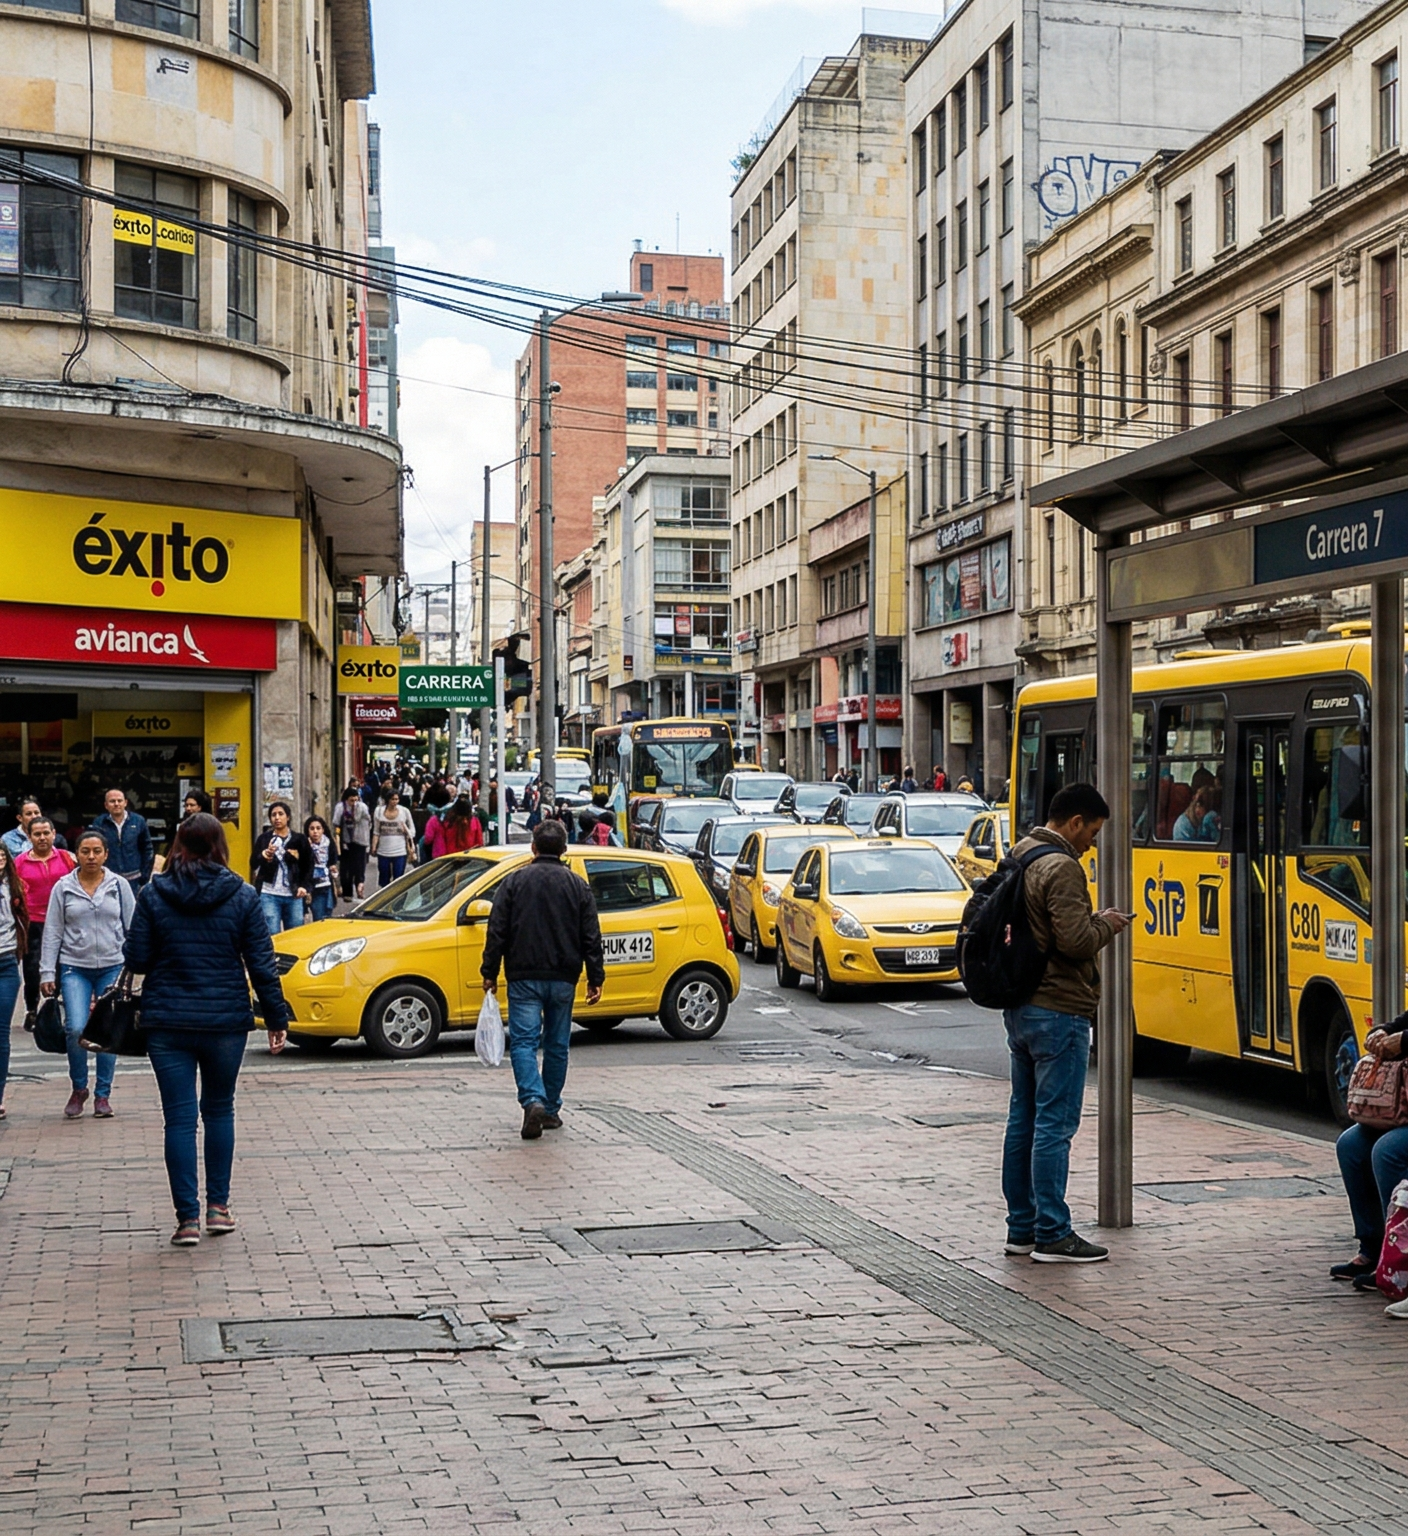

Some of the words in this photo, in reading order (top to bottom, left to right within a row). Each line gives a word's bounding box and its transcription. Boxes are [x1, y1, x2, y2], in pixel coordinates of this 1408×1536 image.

[1306, 521, 1368, 561] Carrera
[1373, 509, 1384, 548] 7
[73, 512, 229, 597] éxito
[75, 622, 179, 655] avianca
[340, 659, 397, 683] éxito
[405, 675, 485, 690] CARRERA
[125, 714, 171, 734] éxito
[1290, 902, 1320, 941] C80
[602, 938, 627, 955] HUK
[629, 937, 652, 953] 412
